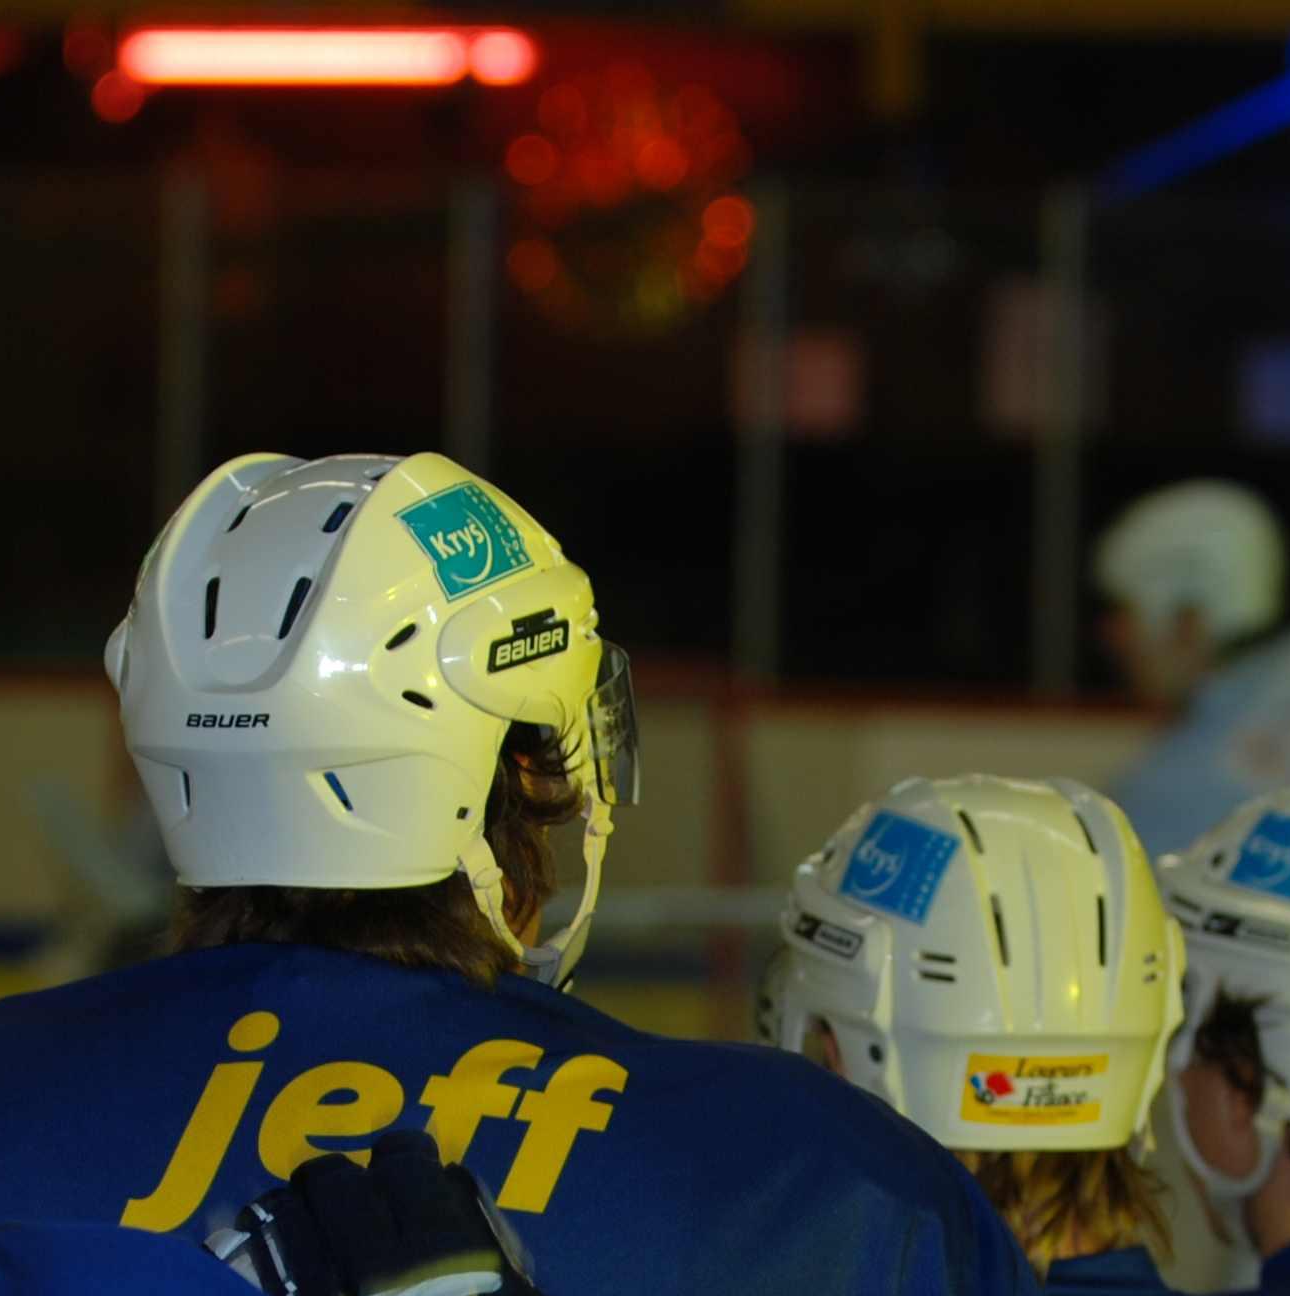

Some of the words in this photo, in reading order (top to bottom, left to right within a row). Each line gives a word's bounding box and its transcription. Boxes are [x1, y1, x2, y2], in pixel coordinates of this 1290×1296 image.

[429, 521, 485, 560] Krys
[495, 627, 564, 666] BAUER
[186, 712, 270, 729] BAUER
[119, 1011, 628, 1234] jeff
